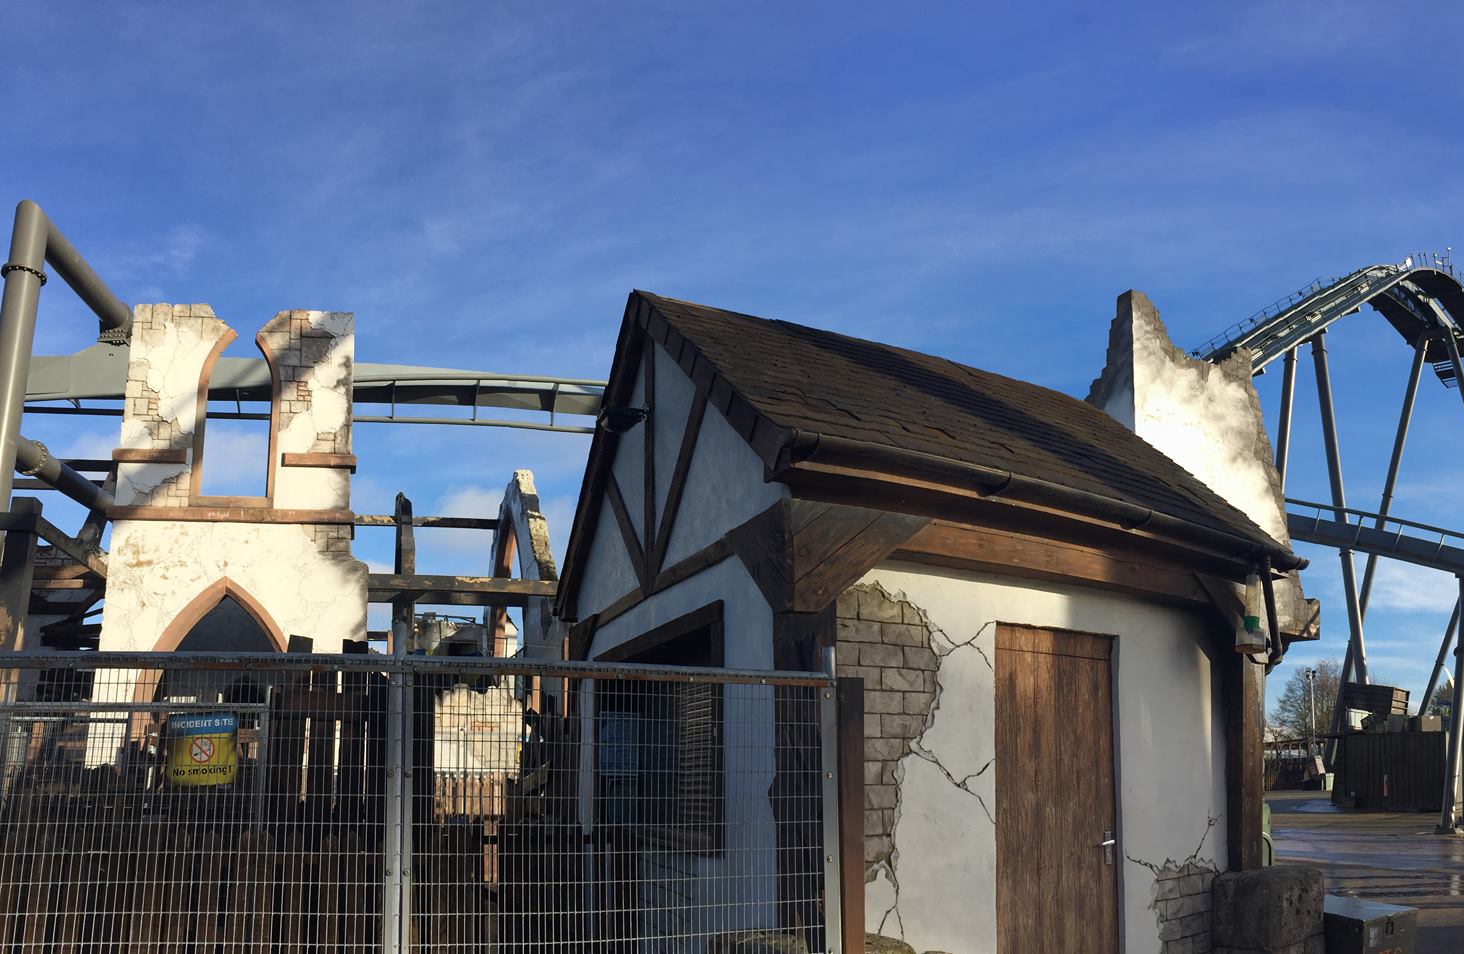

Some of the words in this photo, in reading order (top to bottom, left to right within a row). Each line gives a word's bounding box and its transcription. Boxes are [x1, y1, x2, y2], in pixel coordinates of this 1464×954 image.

[171, 719, 212, 729] INCIDENT
[214, 718, 234, 727] SITE
[172, 768, 185, 777] No
[188, 765, 232, 776] smoking!
